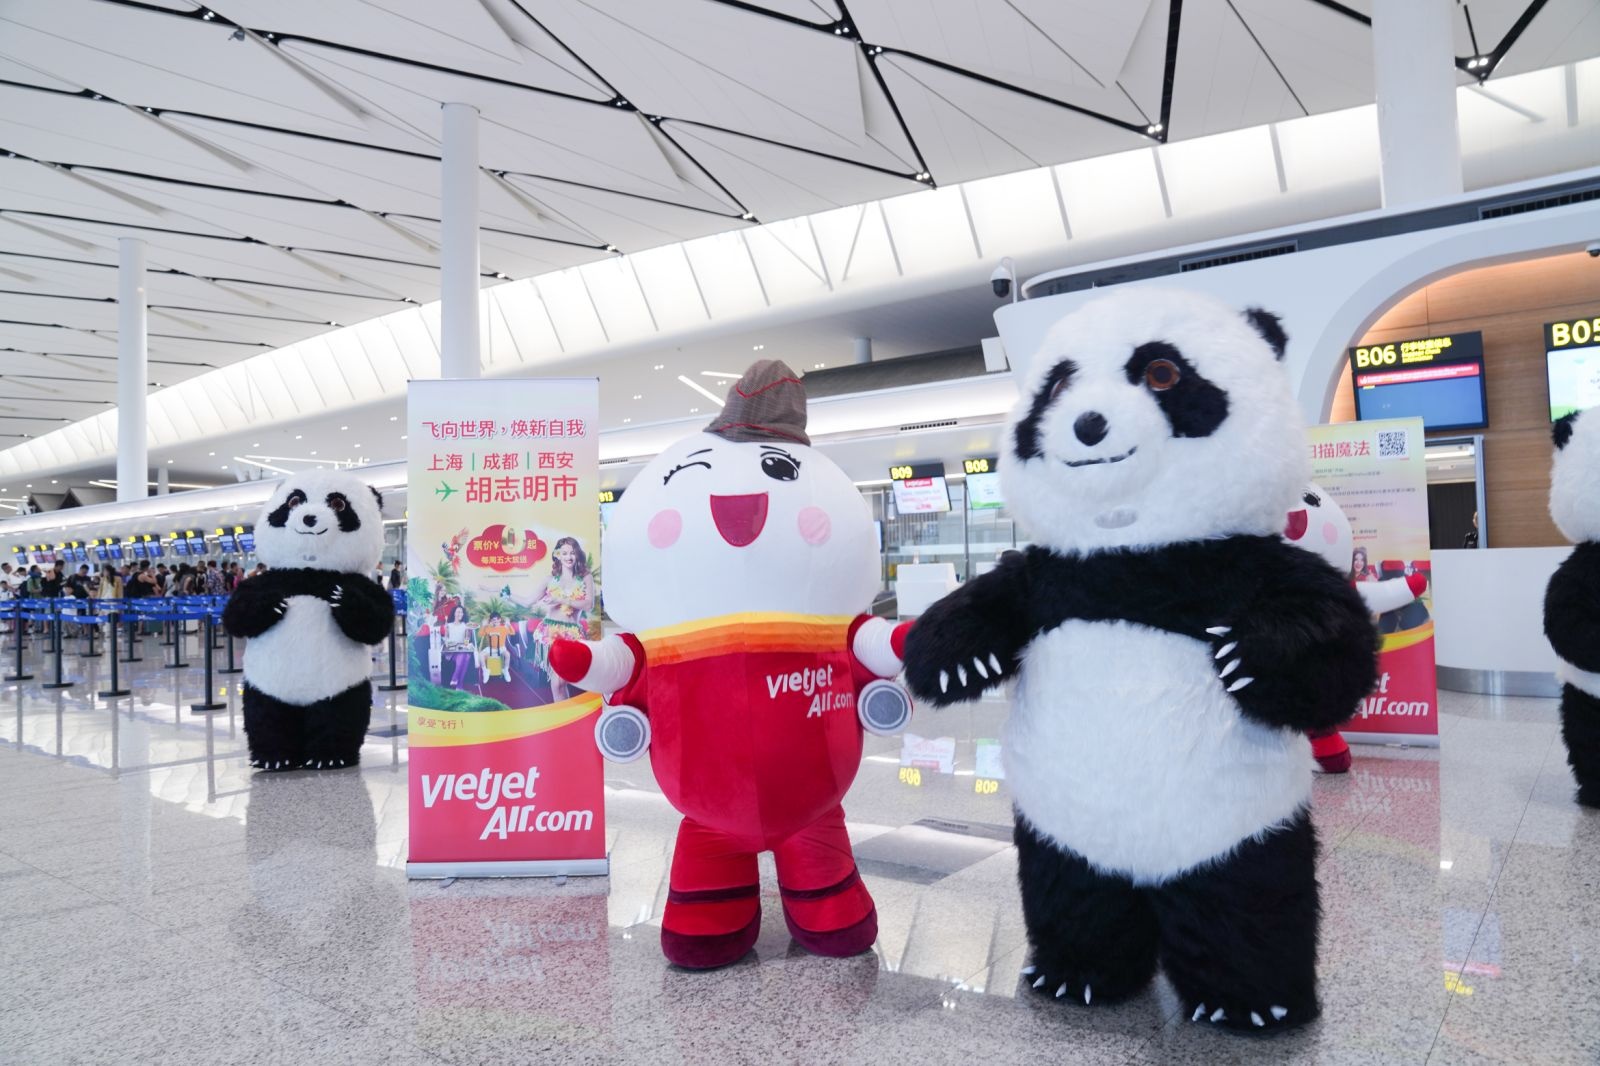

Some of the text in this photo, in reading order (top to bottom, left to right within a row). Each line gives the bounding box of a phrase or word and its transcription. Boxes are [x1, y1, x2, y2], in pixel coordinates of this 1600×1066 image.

[1355, 344, 1397, 367] B06
[422, 419, 585, 439] 飞向世界，焕新自我
[427, 451, 574, 471] 上海 成都 西安
[965, 459, 989, 473] B08
[890, 466, 913, 480] B09
[465, 475, 579, 503] 胡志明市
